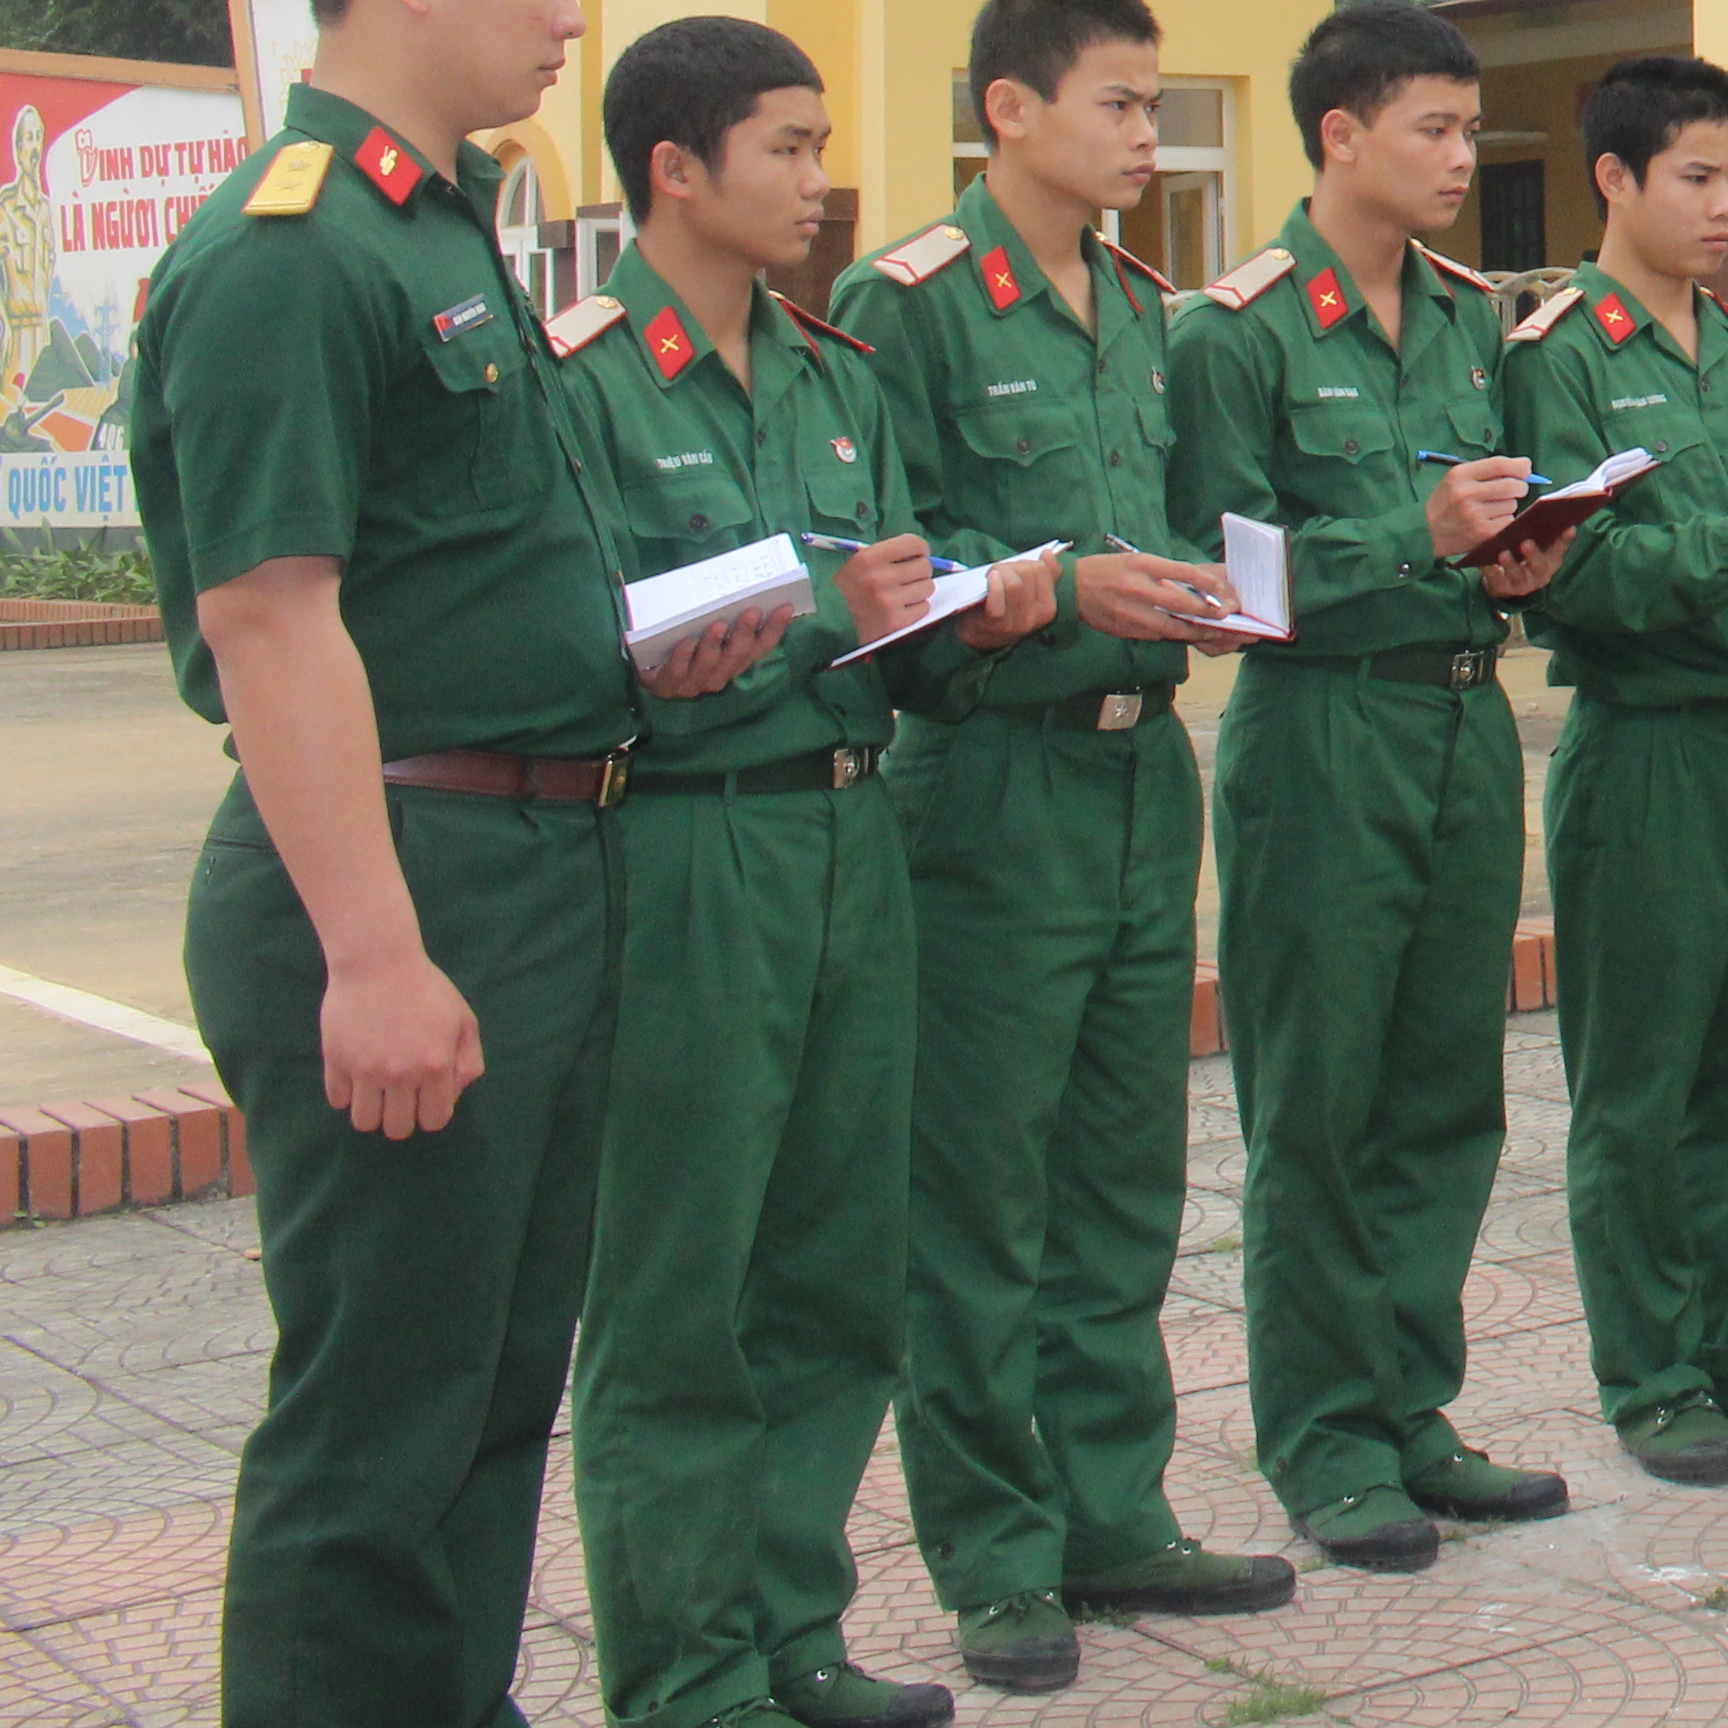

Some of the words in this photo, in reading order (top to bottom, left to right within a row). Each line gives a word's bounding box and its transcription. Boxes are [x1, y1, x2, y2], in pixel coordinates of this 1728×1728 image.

[140, 144, 172, 187] DỰ
[173, 140, 206, 184] TỰ
[60, 189, 87, 253] LÀ
[91, 187, 160, 251] NGƯỜI
[8, 456, 67, 520] QUỐC
[74, 454, 127, 522] VIỆT
